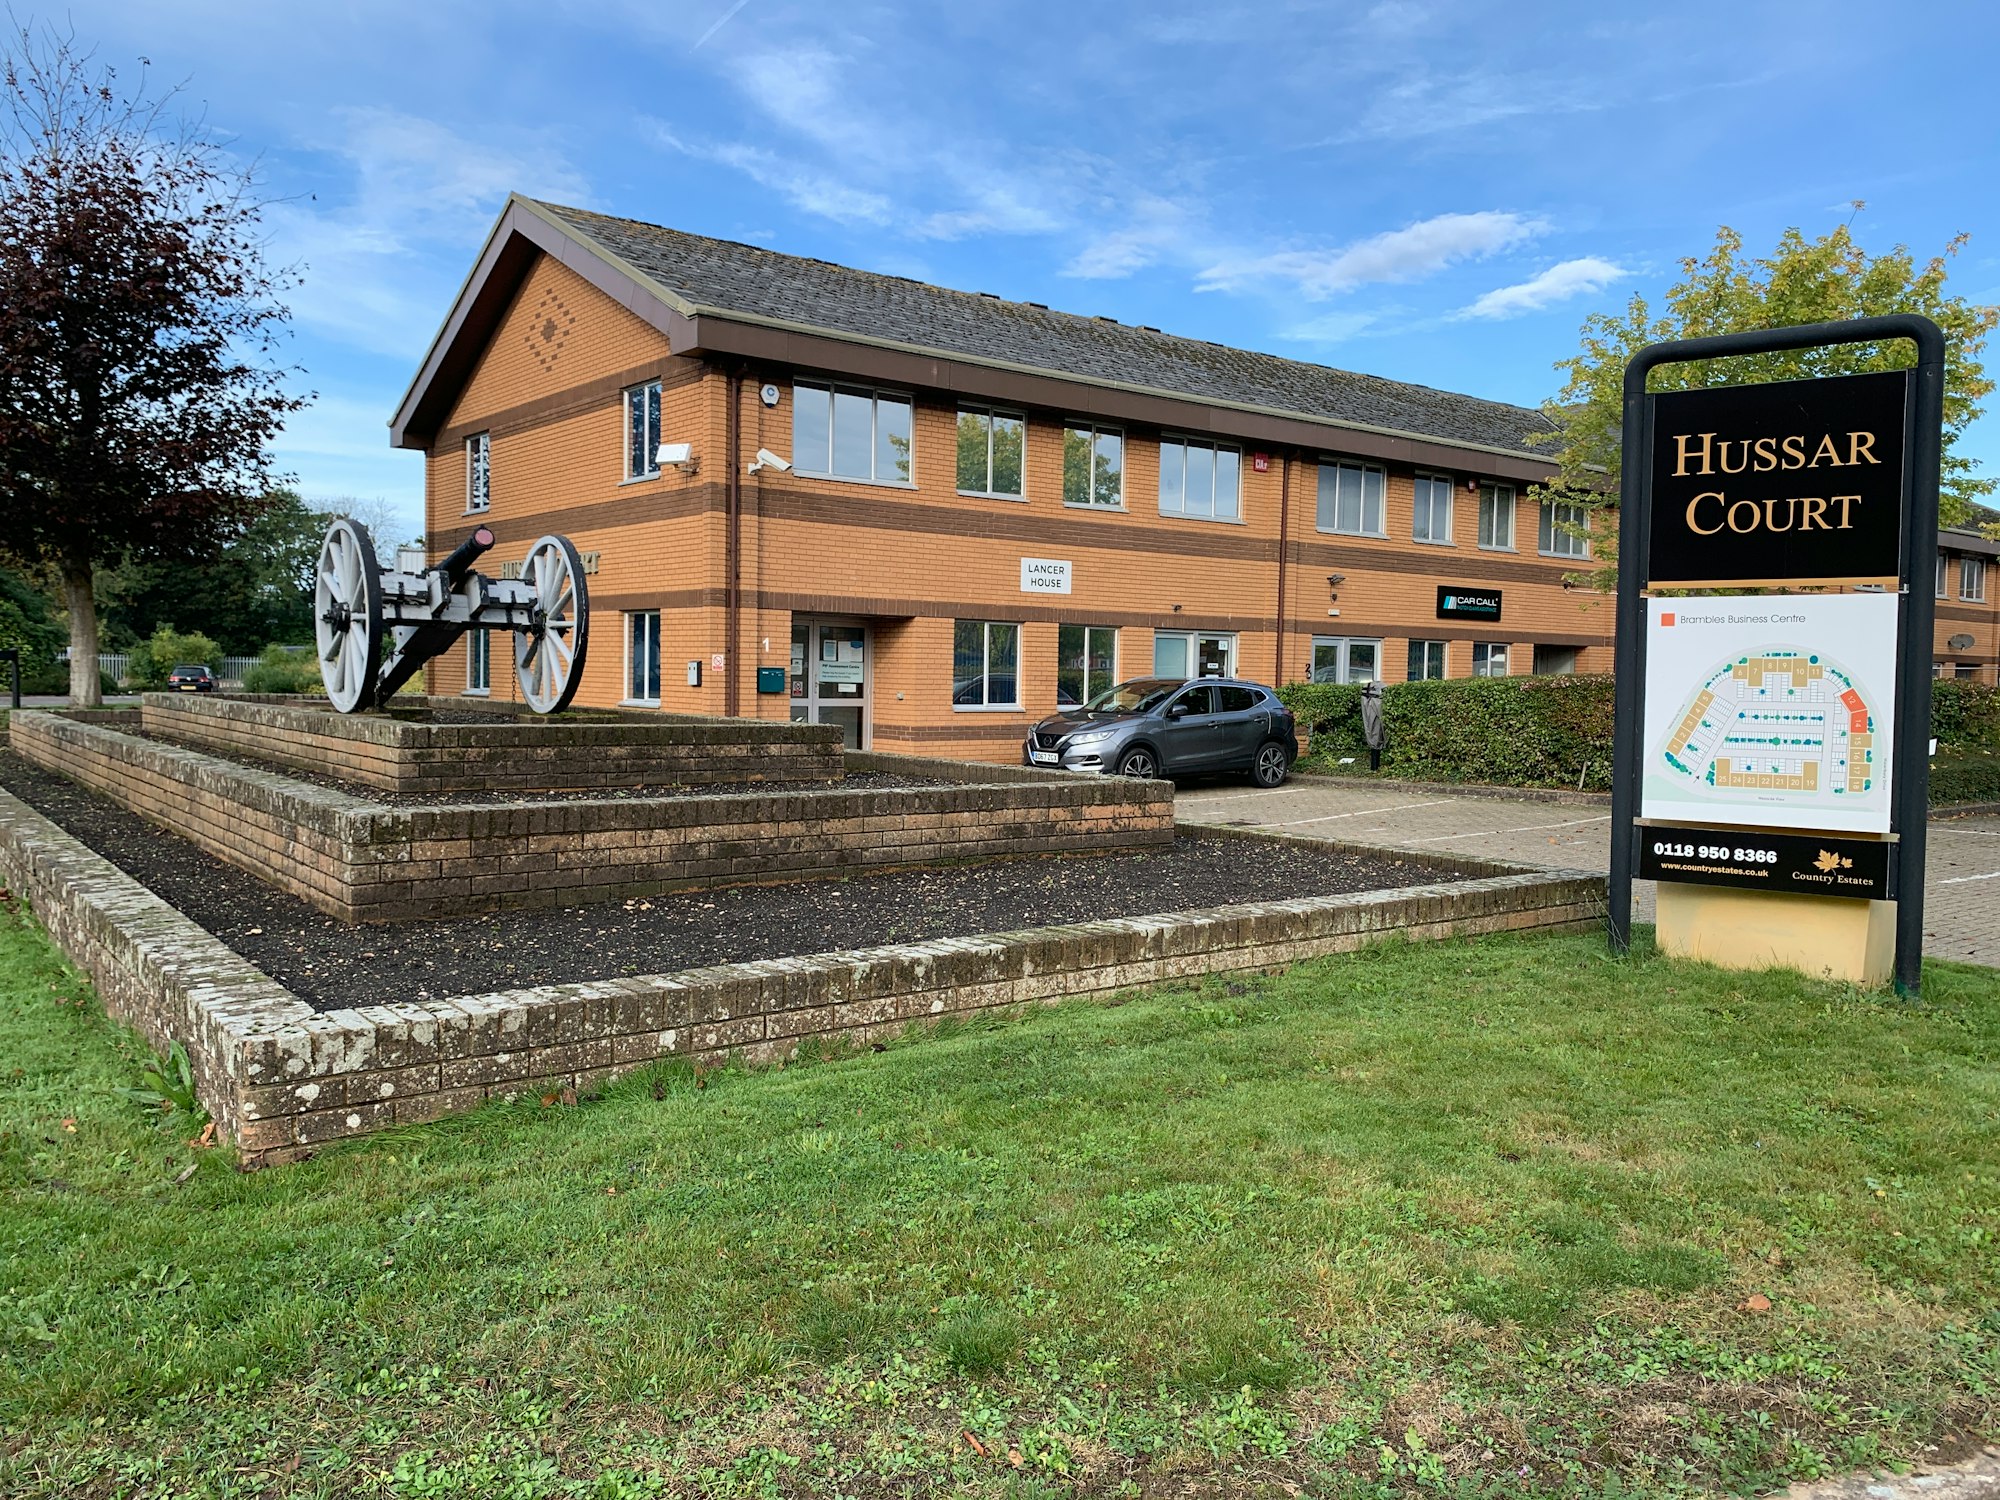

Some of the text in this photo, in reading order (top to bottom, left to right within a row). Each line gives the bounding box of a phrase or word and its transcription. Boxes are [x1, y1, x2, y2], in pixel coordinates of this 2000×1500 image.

[1671, 431, 1882, 477] HUSSAR
[1685, 491, 1862, 535] COURT
[1028, 564, 1065, 575] LANCER
[1030, 578, 1062, 588] HOUSE
[1458, 596, 1476, 604] CAR
[1680, 614, 1806, 624] Brambles Business Centre
[762, 637, 770, 652] 1
[1654, 842, 1778, 864] 0118 950 8366
[1660, 862, 1769, 878] www.countryestates.co.uk
[1792, 871, 1874, 886] Country Estates
